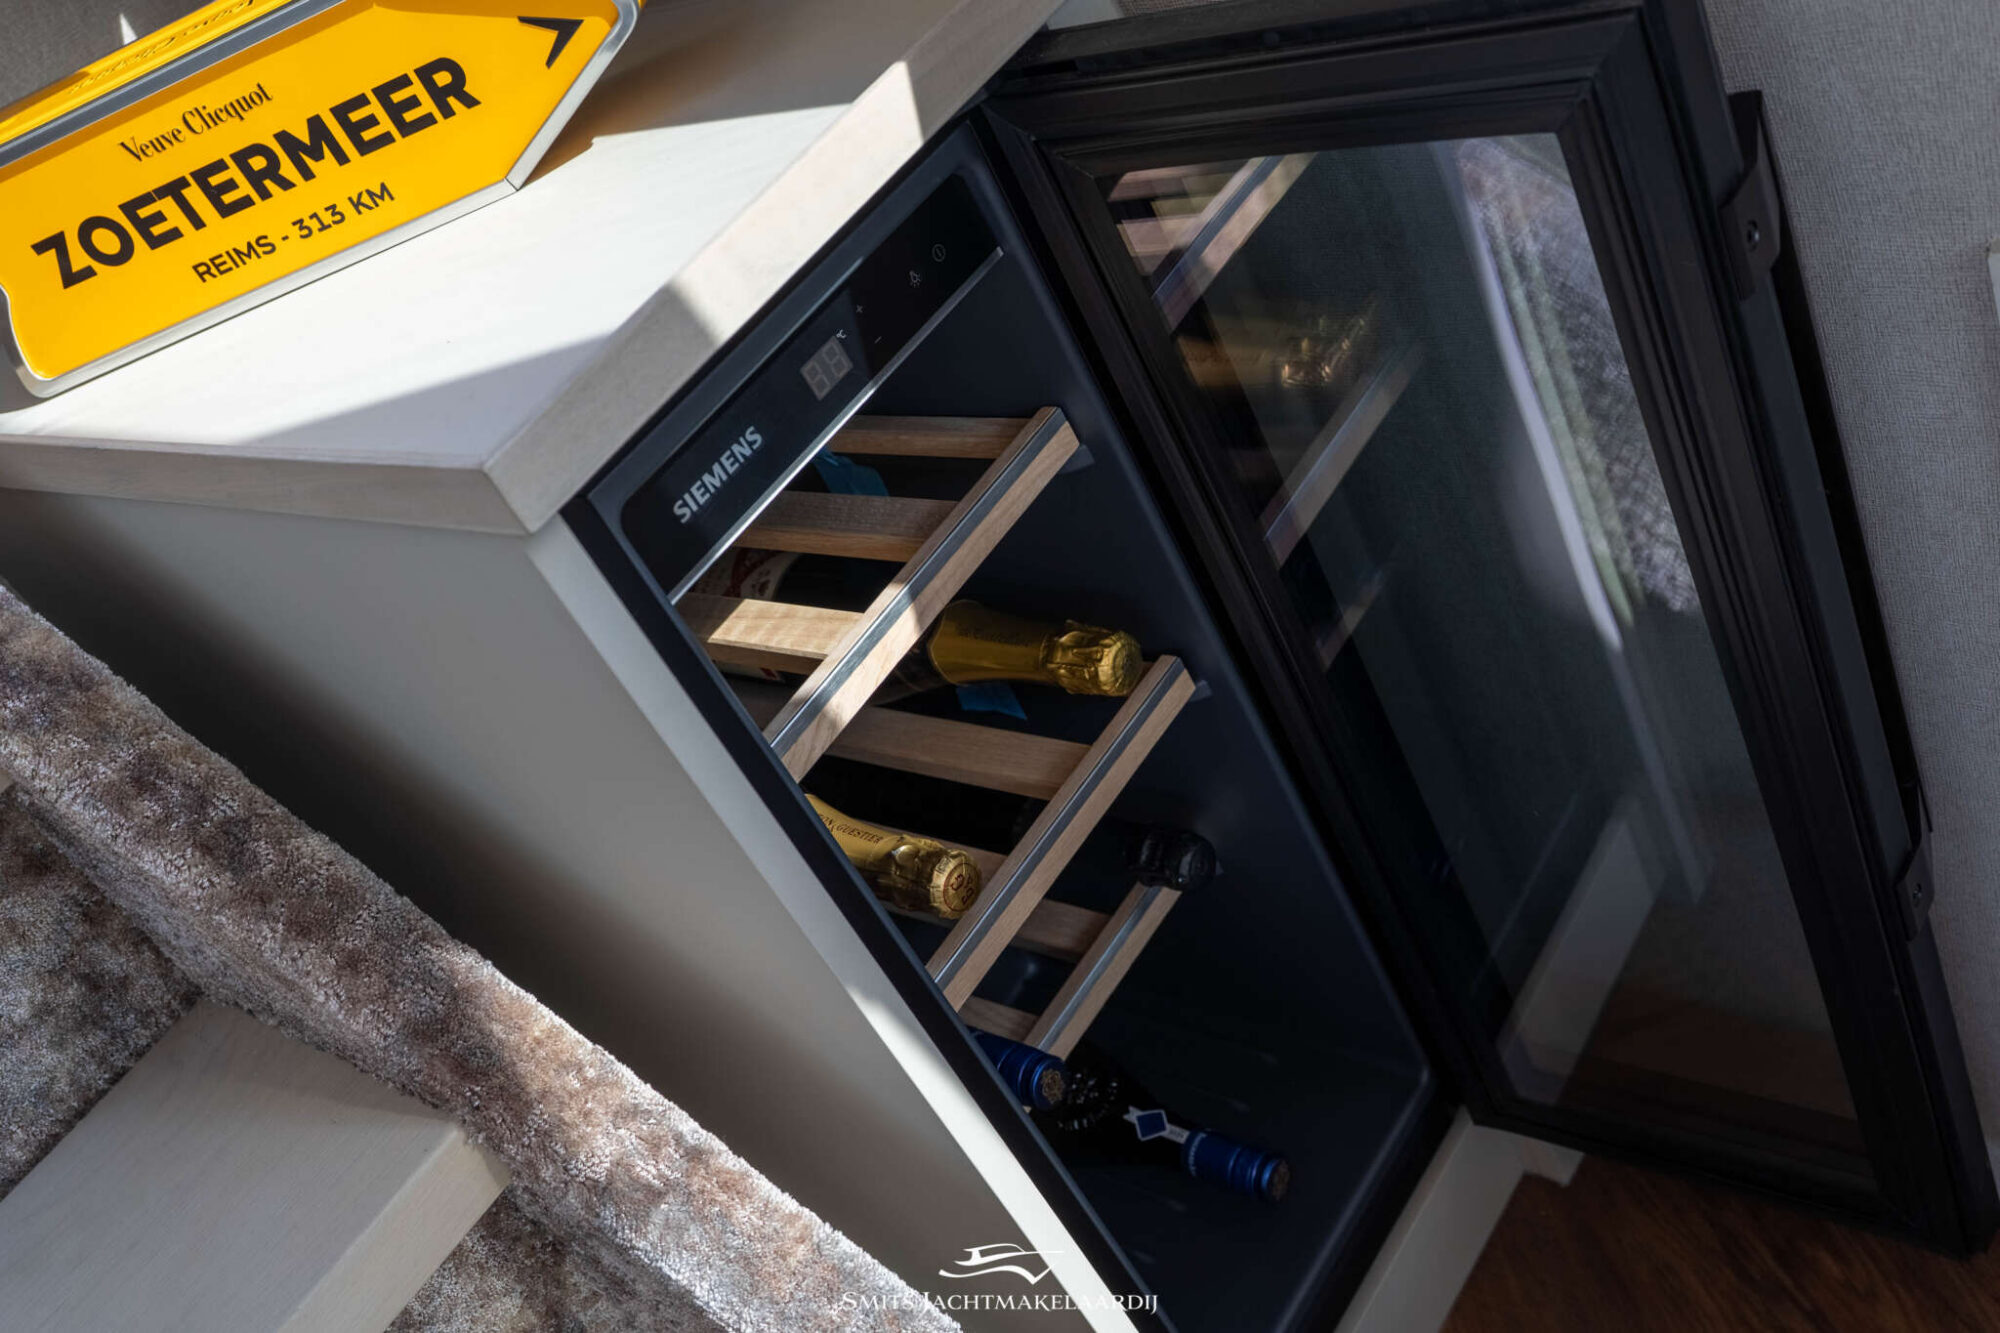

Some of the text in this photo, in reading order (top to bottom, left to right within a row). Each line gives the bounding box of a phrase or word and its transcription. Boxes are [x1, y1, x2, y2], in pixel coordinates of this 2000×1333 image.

[31, 56, 482, 290] ZOETERMEER
[119, 82, 273, 163] Veuve Clicquot
[192, 235, 277, 283] REIMS
[291, 204, 347, 240] 313
[348, 181, 396, 216] KM
[672, 425, 764, 525] SIEMENS
